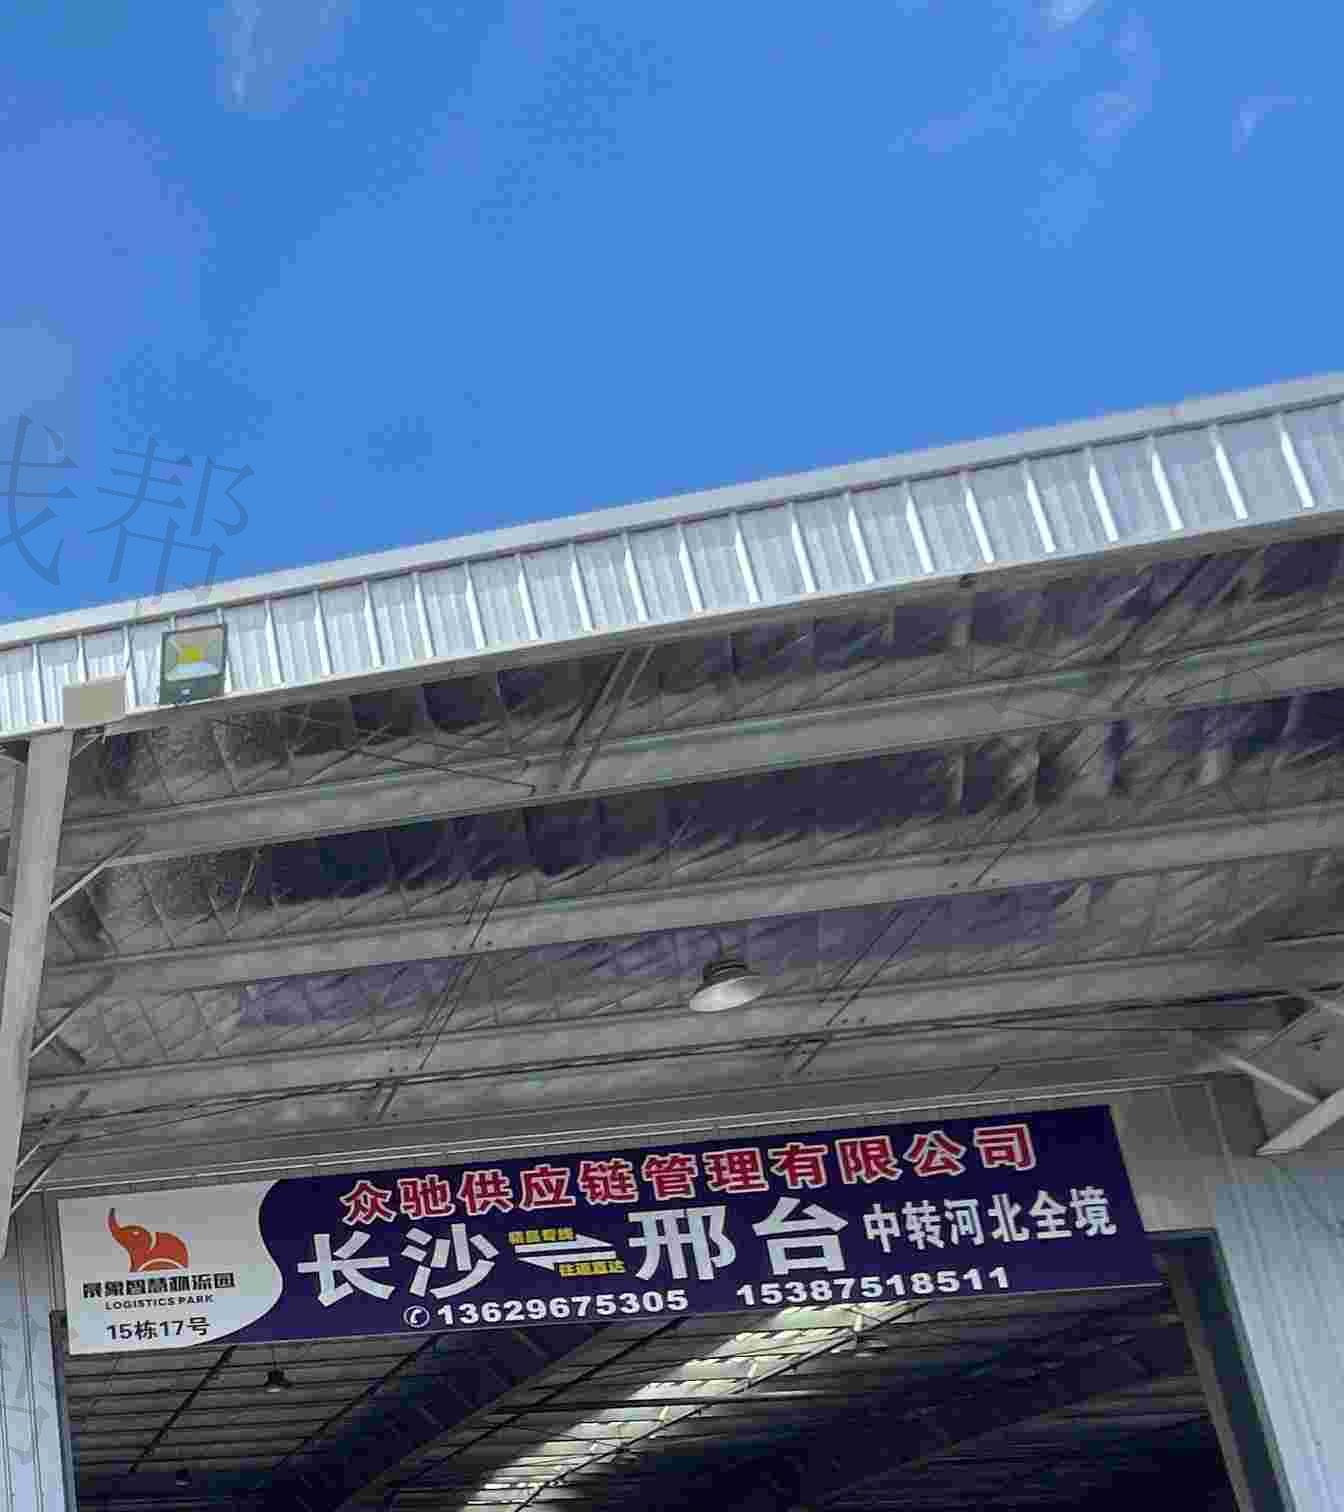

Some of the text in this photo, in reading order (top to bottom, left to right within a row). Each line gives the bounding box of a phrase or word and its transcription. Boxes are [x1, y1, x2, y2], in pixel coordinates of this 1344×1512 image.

[341, 1123, 1036, 1225] 众驰供应链管理有限公司
[297, 1185, 1117, 1306] 长沙 邢台 中转河北全境
[105, 1294, 214, 1311] LOGISTICS PARK
[437, 1266, 1009, 1325] 13629675305 15387518511
[106, 1316, 210, 1340] 15栋17号
